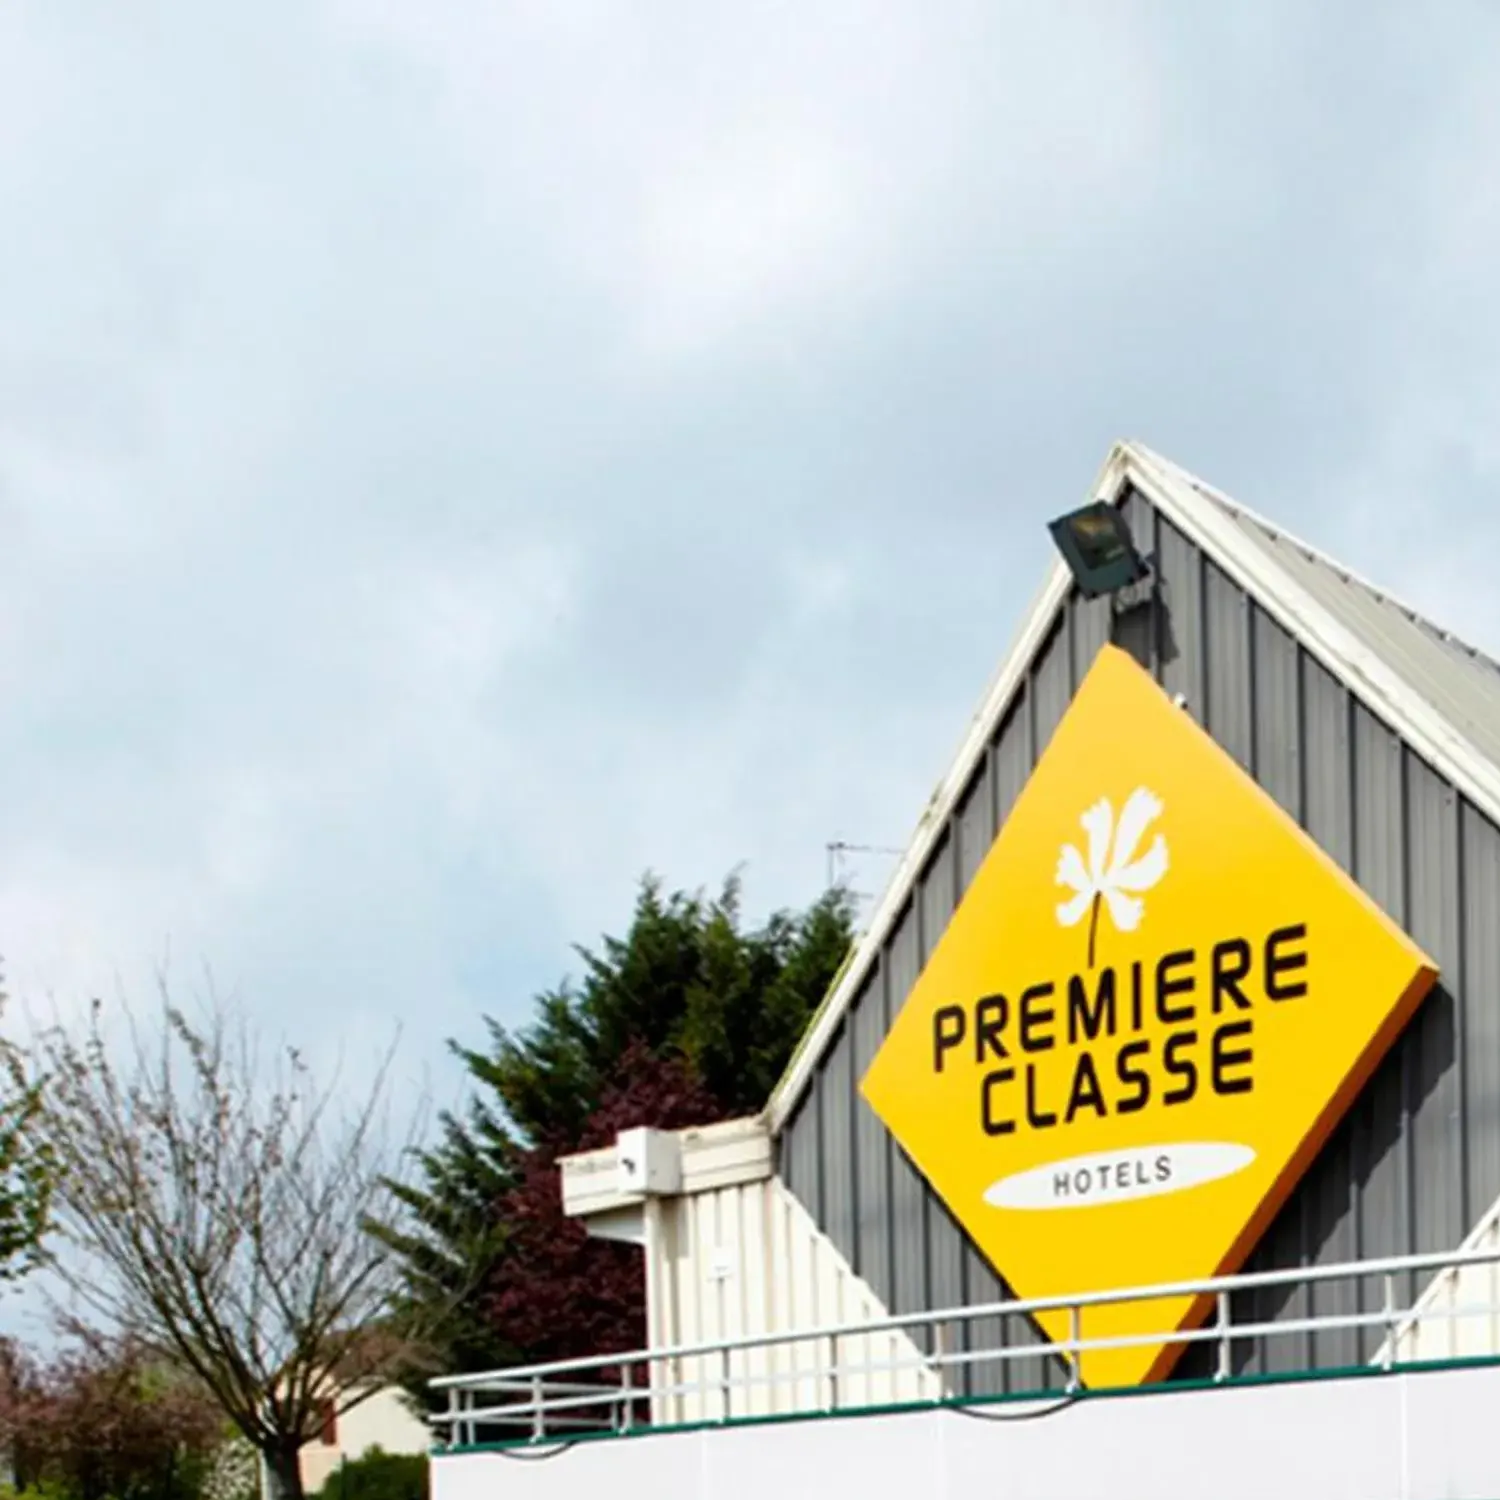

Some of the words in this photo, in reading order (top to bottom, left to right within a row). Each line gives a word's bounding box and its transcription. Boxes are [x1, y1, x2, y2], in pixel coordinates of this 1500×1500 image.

[933, 924, 1307, 1073] PREMIERE
[981, 1021, 1253, 1136] CLASSE
[1053, 1156, 1172, 1196] HOTELS
